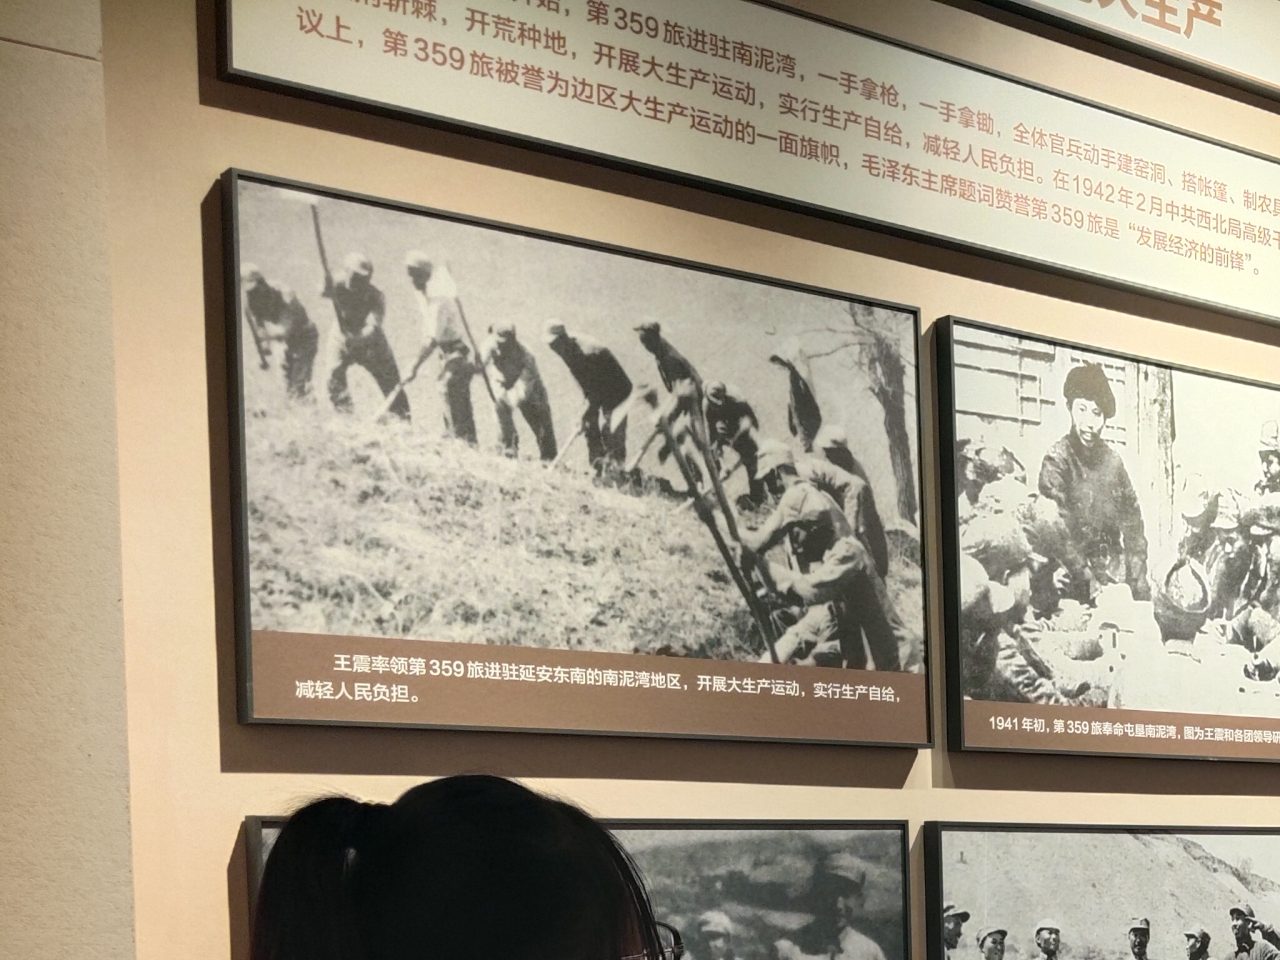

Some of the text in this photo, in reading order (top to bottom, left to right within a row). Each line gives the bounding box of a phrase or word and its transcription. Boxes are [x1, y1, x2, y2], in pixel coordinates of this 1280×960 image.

[295, 680, 420, 703] 减轻人民负担。
[333, 653, 901, 703] 王震率领第359旅进驻延安东南的南泥湾地区，开展大生产运动，实行生产自给，
